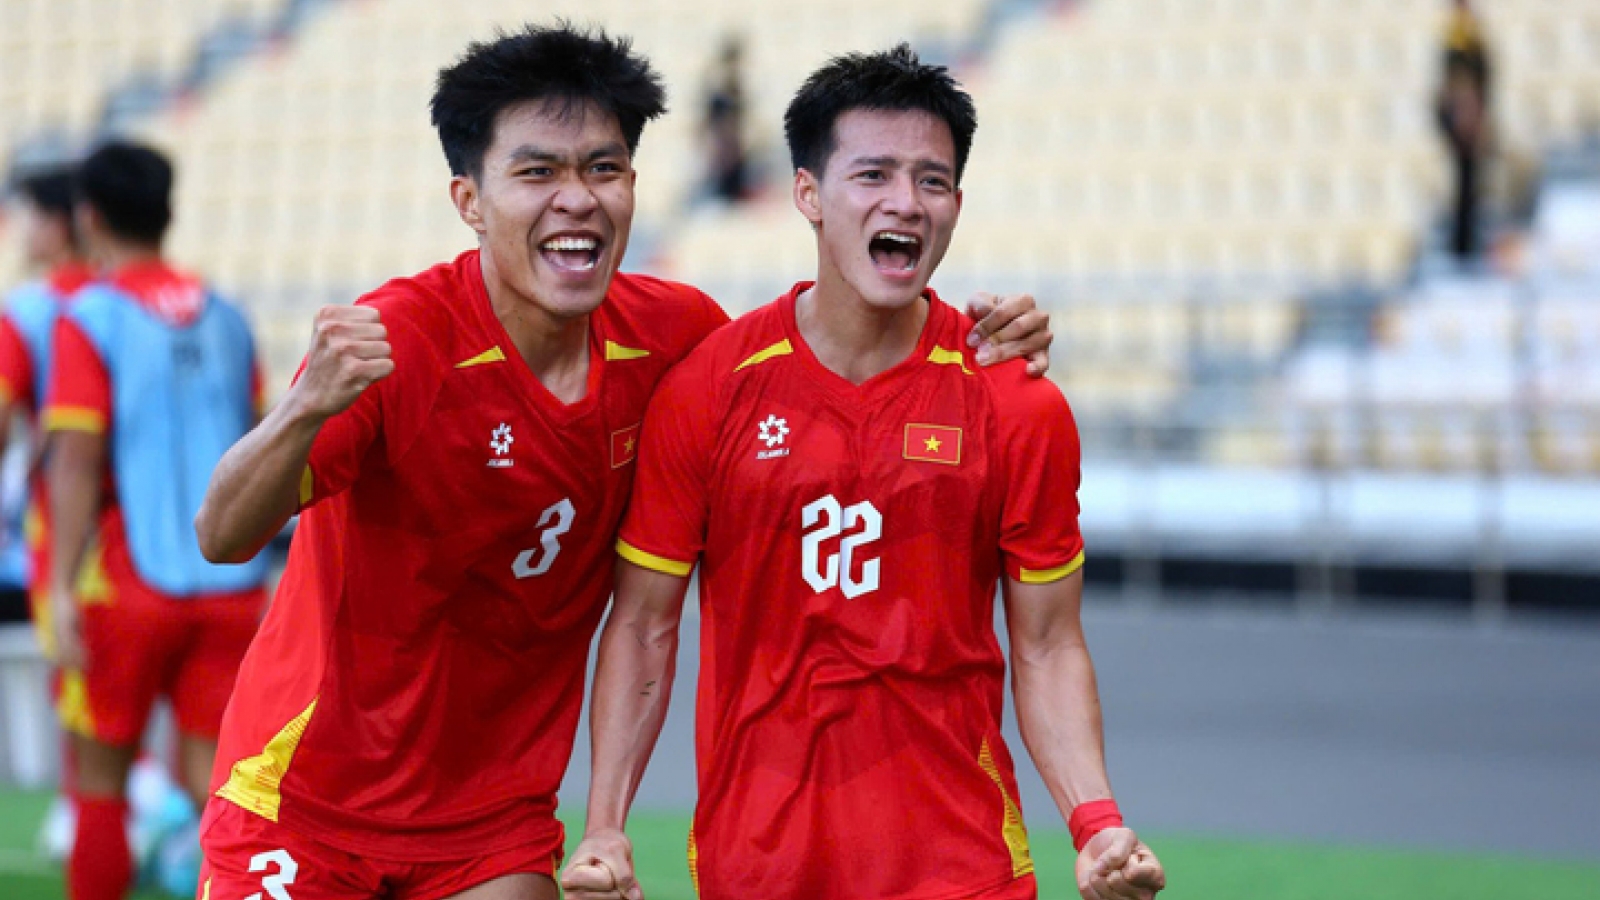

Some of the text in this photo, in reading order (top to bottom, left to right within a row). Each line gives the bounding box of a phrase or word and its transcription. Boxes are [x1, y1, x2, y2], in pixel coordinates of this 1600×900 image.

[511, 497, 576, 579] 3
[801, 494, 882, 599] 22
[244, 848, 298, 900] 3
